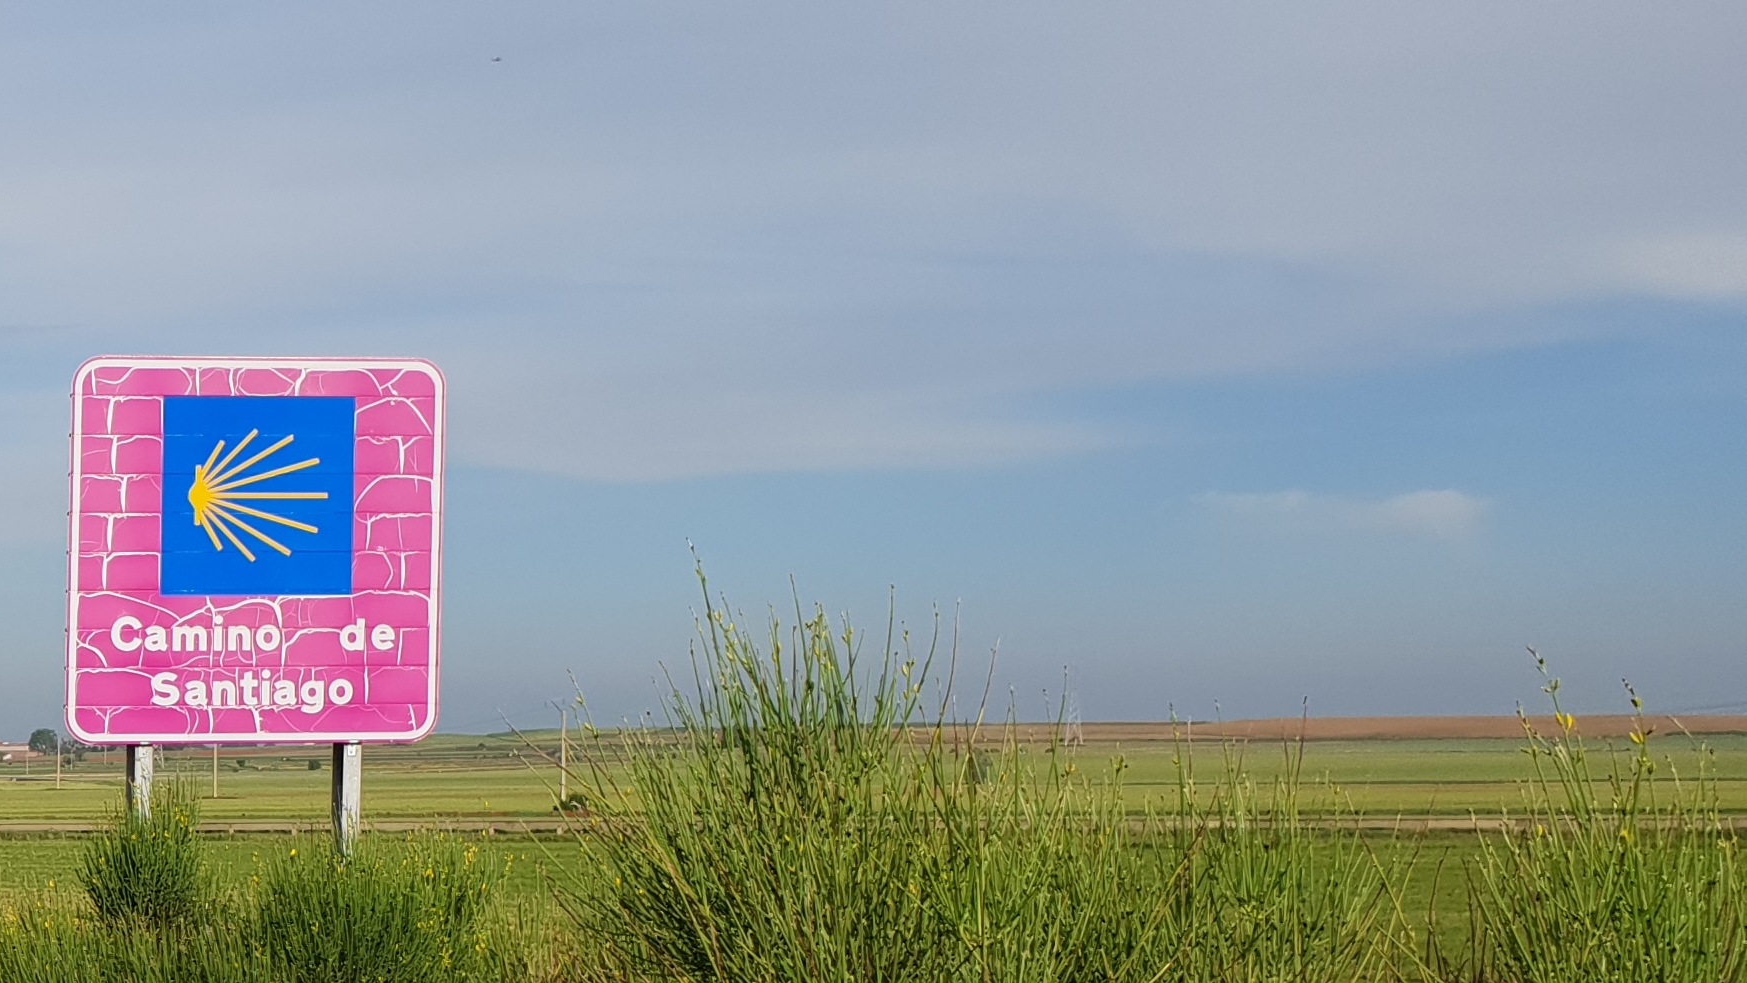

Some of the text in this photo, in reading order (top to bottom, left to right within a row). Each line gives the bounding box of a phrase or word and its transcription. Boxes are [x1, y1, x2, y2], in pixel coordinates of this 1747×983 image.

[110, 615, 396, 652] Camino de
[151, 669, 353, 714] Santiago
